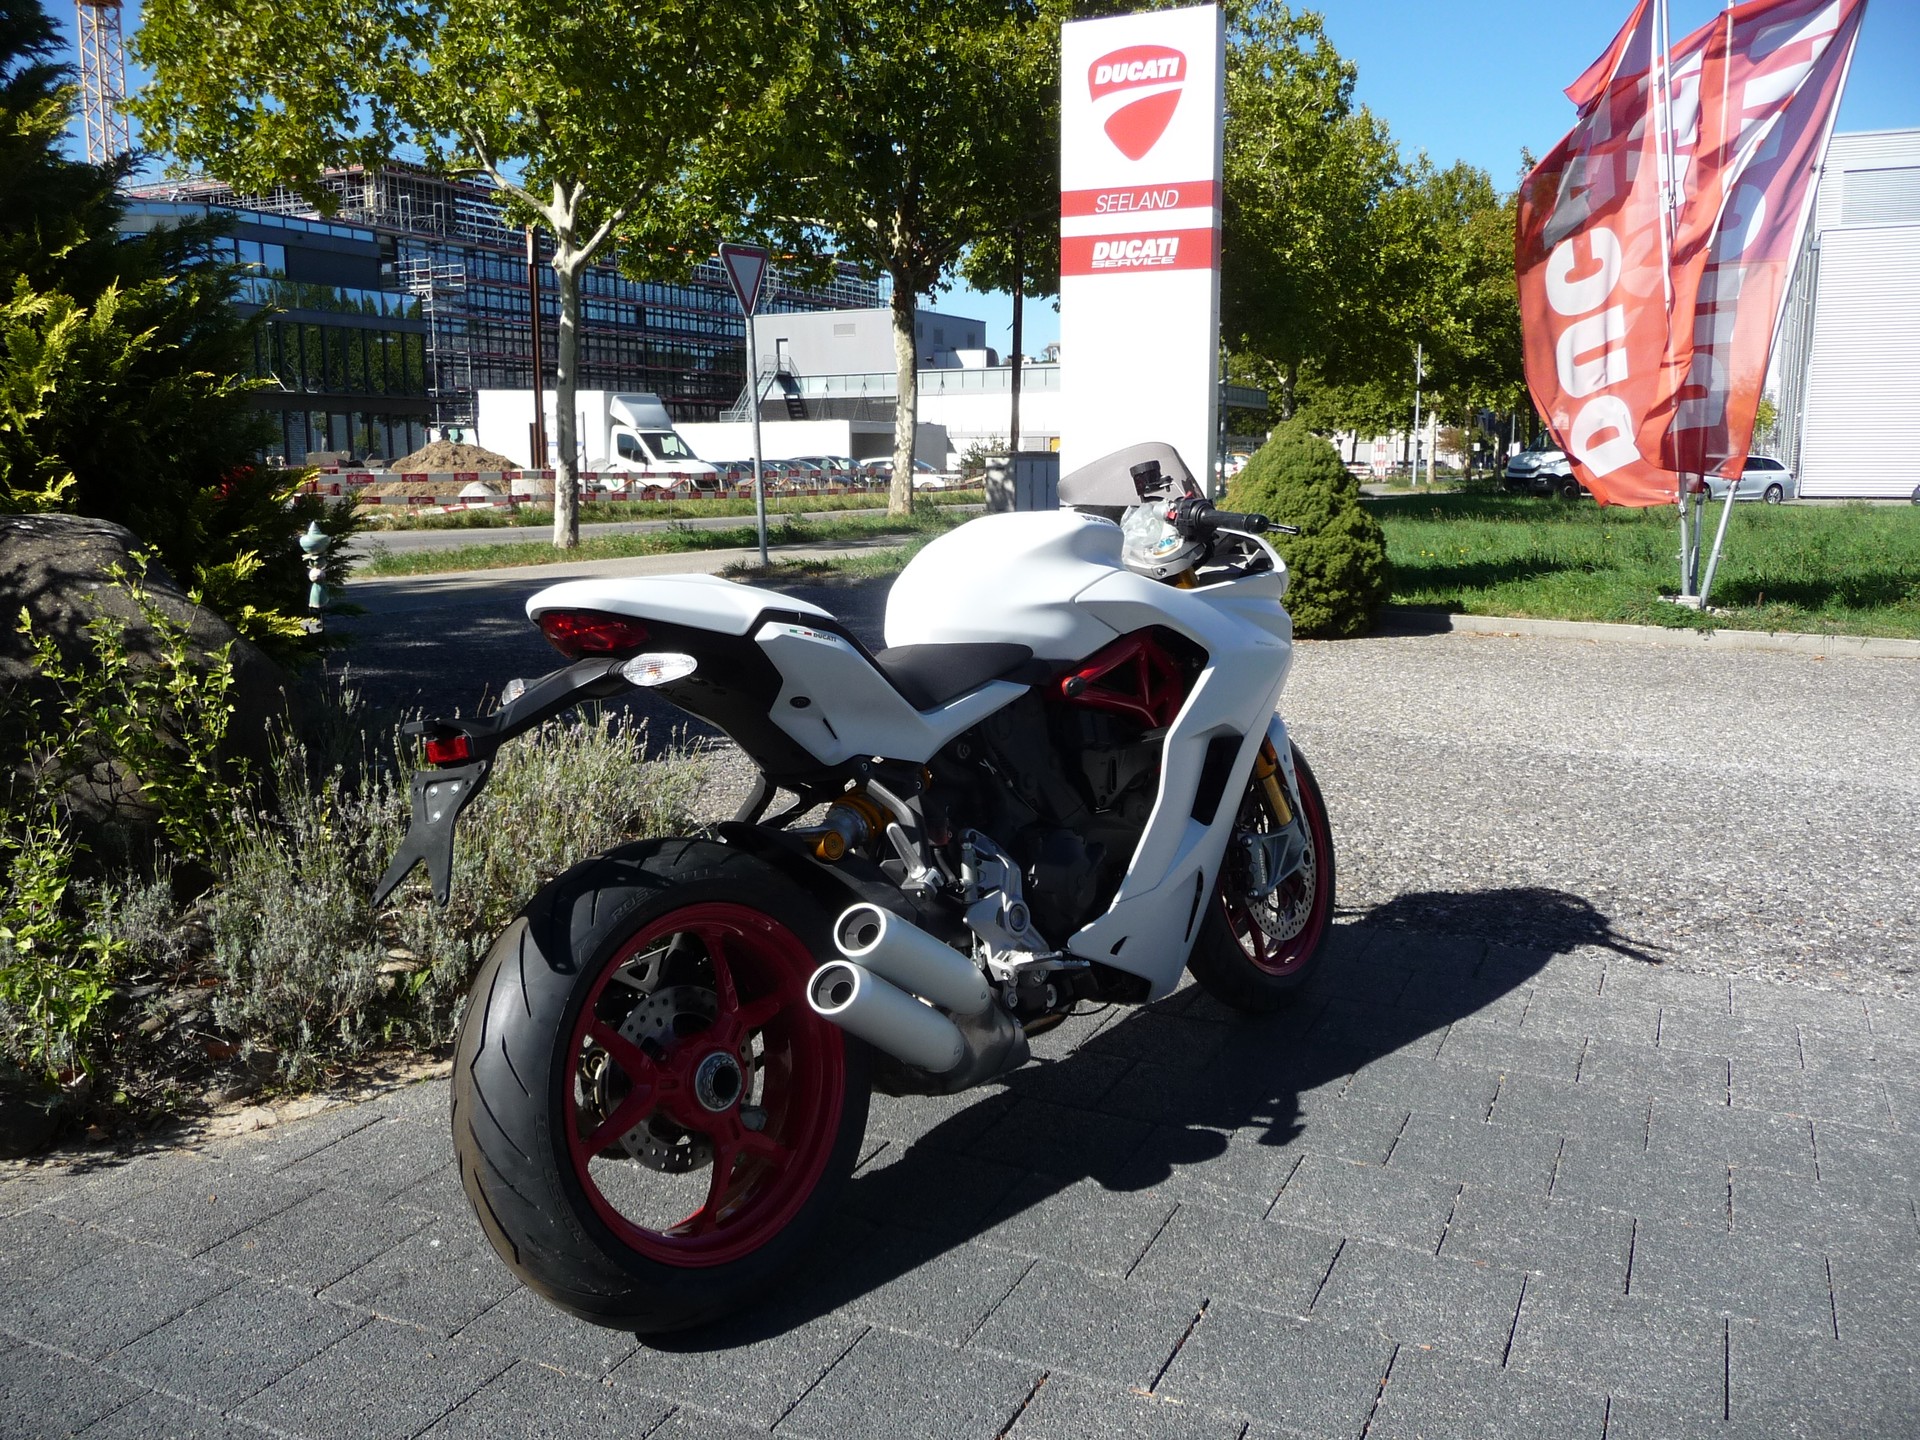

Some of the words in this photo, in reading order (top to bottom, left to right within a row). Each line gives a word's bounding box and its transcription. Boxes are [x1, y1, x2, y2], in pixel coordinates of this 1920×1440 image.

[1095, 57, 1180, 85] DUCATI
[1095, 190, 1179, 213] SEELAND
[1092, 237, 1179, 260] DUCATI
[1091, 256, 1176, 268] SERVICE
[813, 632, 837, 643] DUCATI
